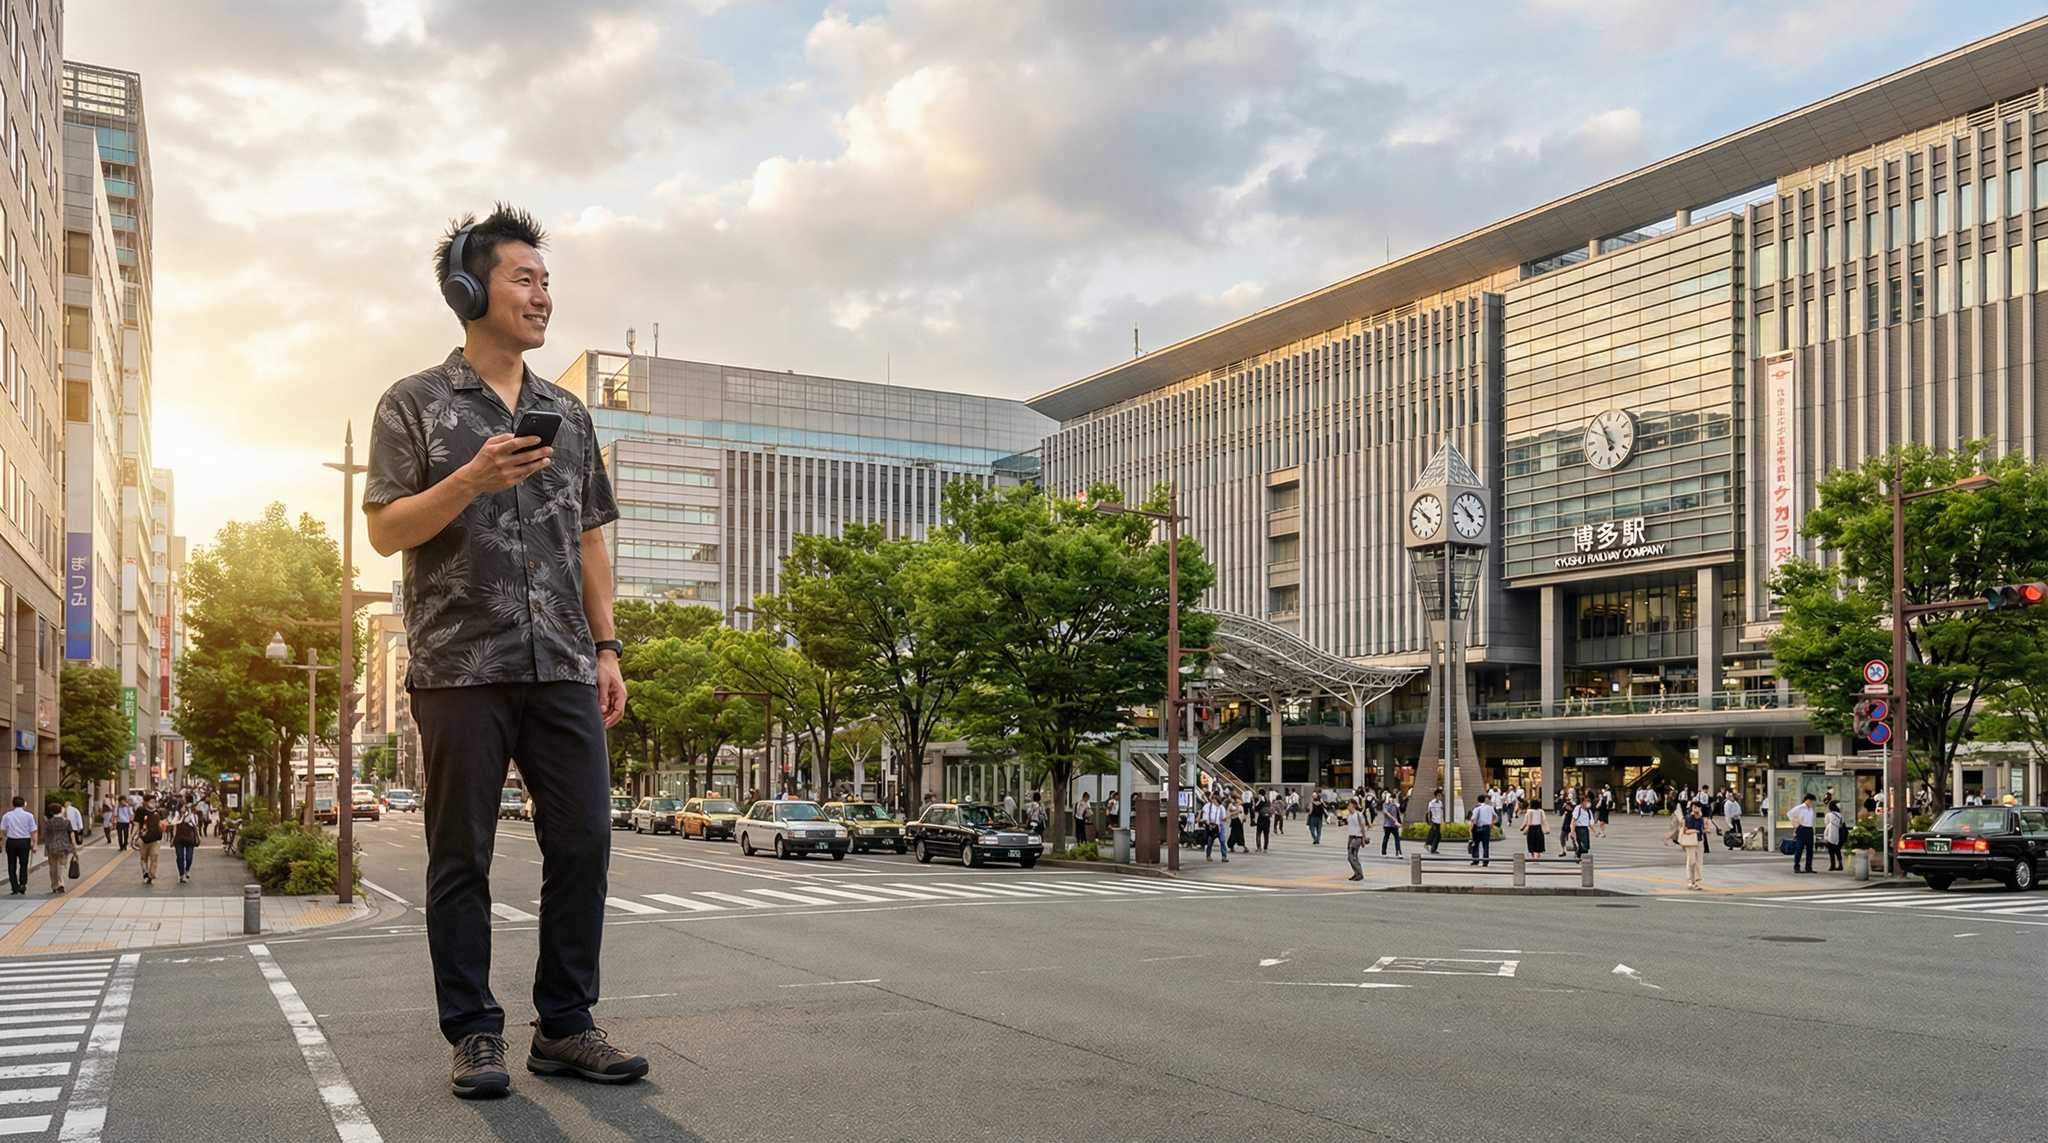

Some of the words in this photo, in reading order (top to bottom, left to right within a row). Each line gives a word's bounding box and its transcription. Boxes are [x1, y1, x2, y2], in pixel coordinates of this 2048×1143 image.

[1573, 517, 1646, 553] 博多駅
[1587, 550, 1622, 564] RAILWAY
[1622, 544, 1665, 559] COMPANY
